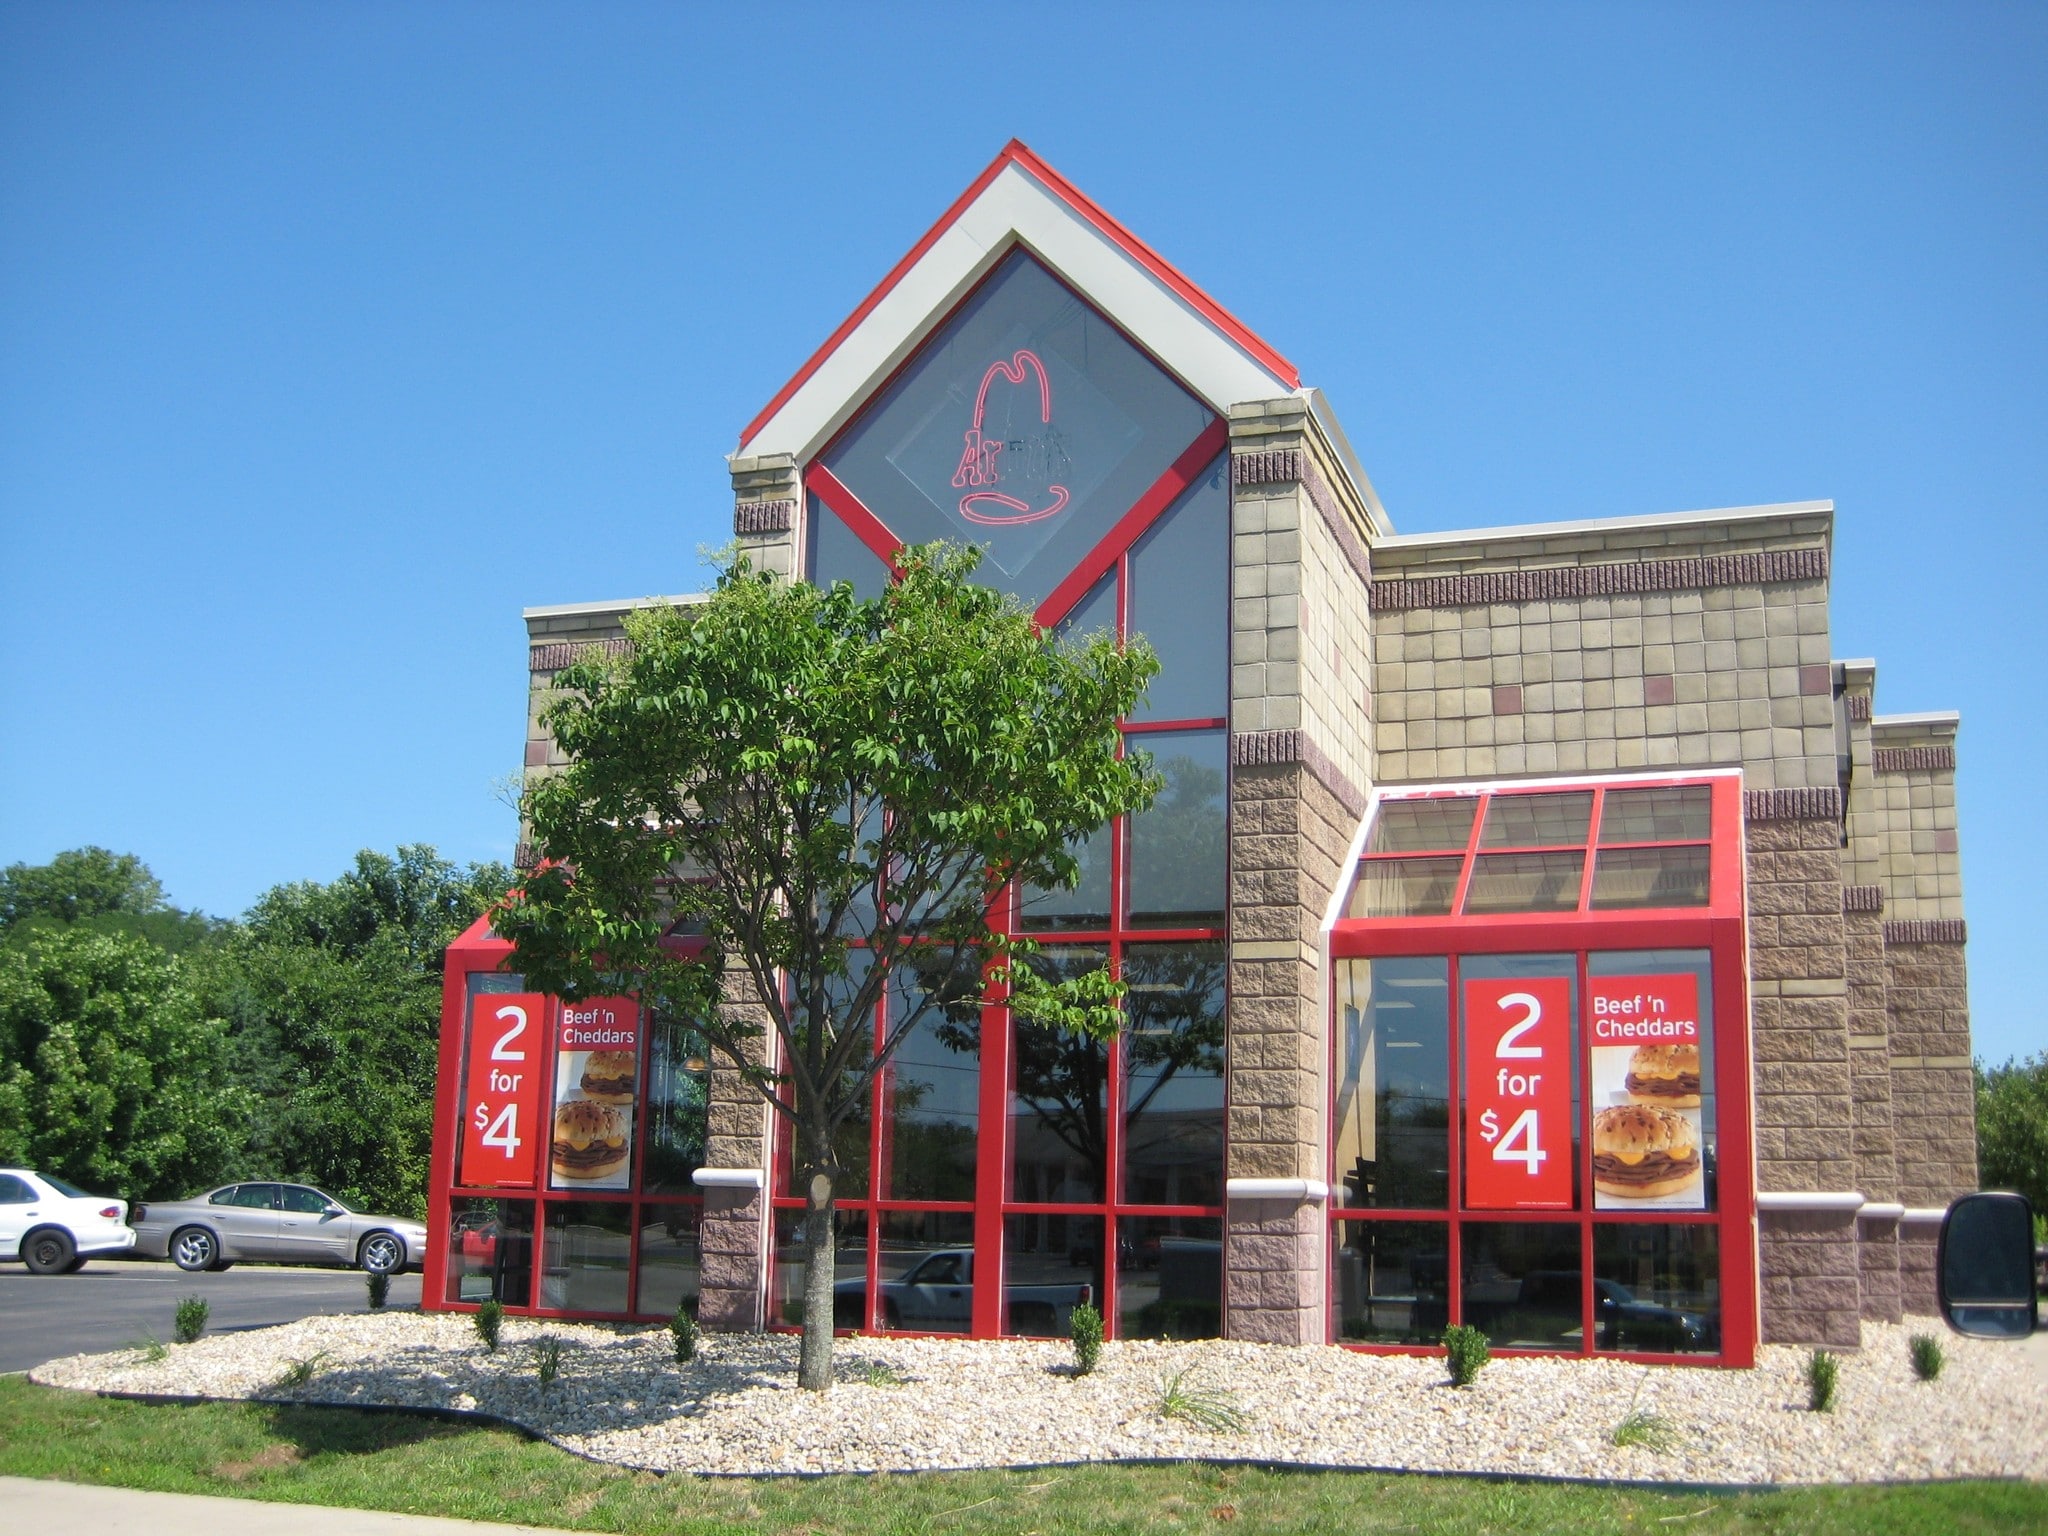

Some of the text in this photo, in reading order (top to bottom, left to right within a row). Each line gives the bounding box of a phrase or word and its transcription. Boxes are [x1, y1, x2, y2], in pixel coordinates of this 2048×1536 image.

[563, 1008, 615, 1025] Beef 'n
[1593, 994, 1665, 1015] Beef 'n
[490, 1005, 528, 1061] 2
[563, 1028, 635, 1044] Cheddars
[1495, 992, 1543, 1059] 2
[1595, 1017, 1696, 1038] Cheddars
[489, 1068, 523, 1093] for
[1496, 1067, 1542, 1096] for
[474, 1101, 522, 1159] $4
[1479, 1108, 1547, 1175] $4
